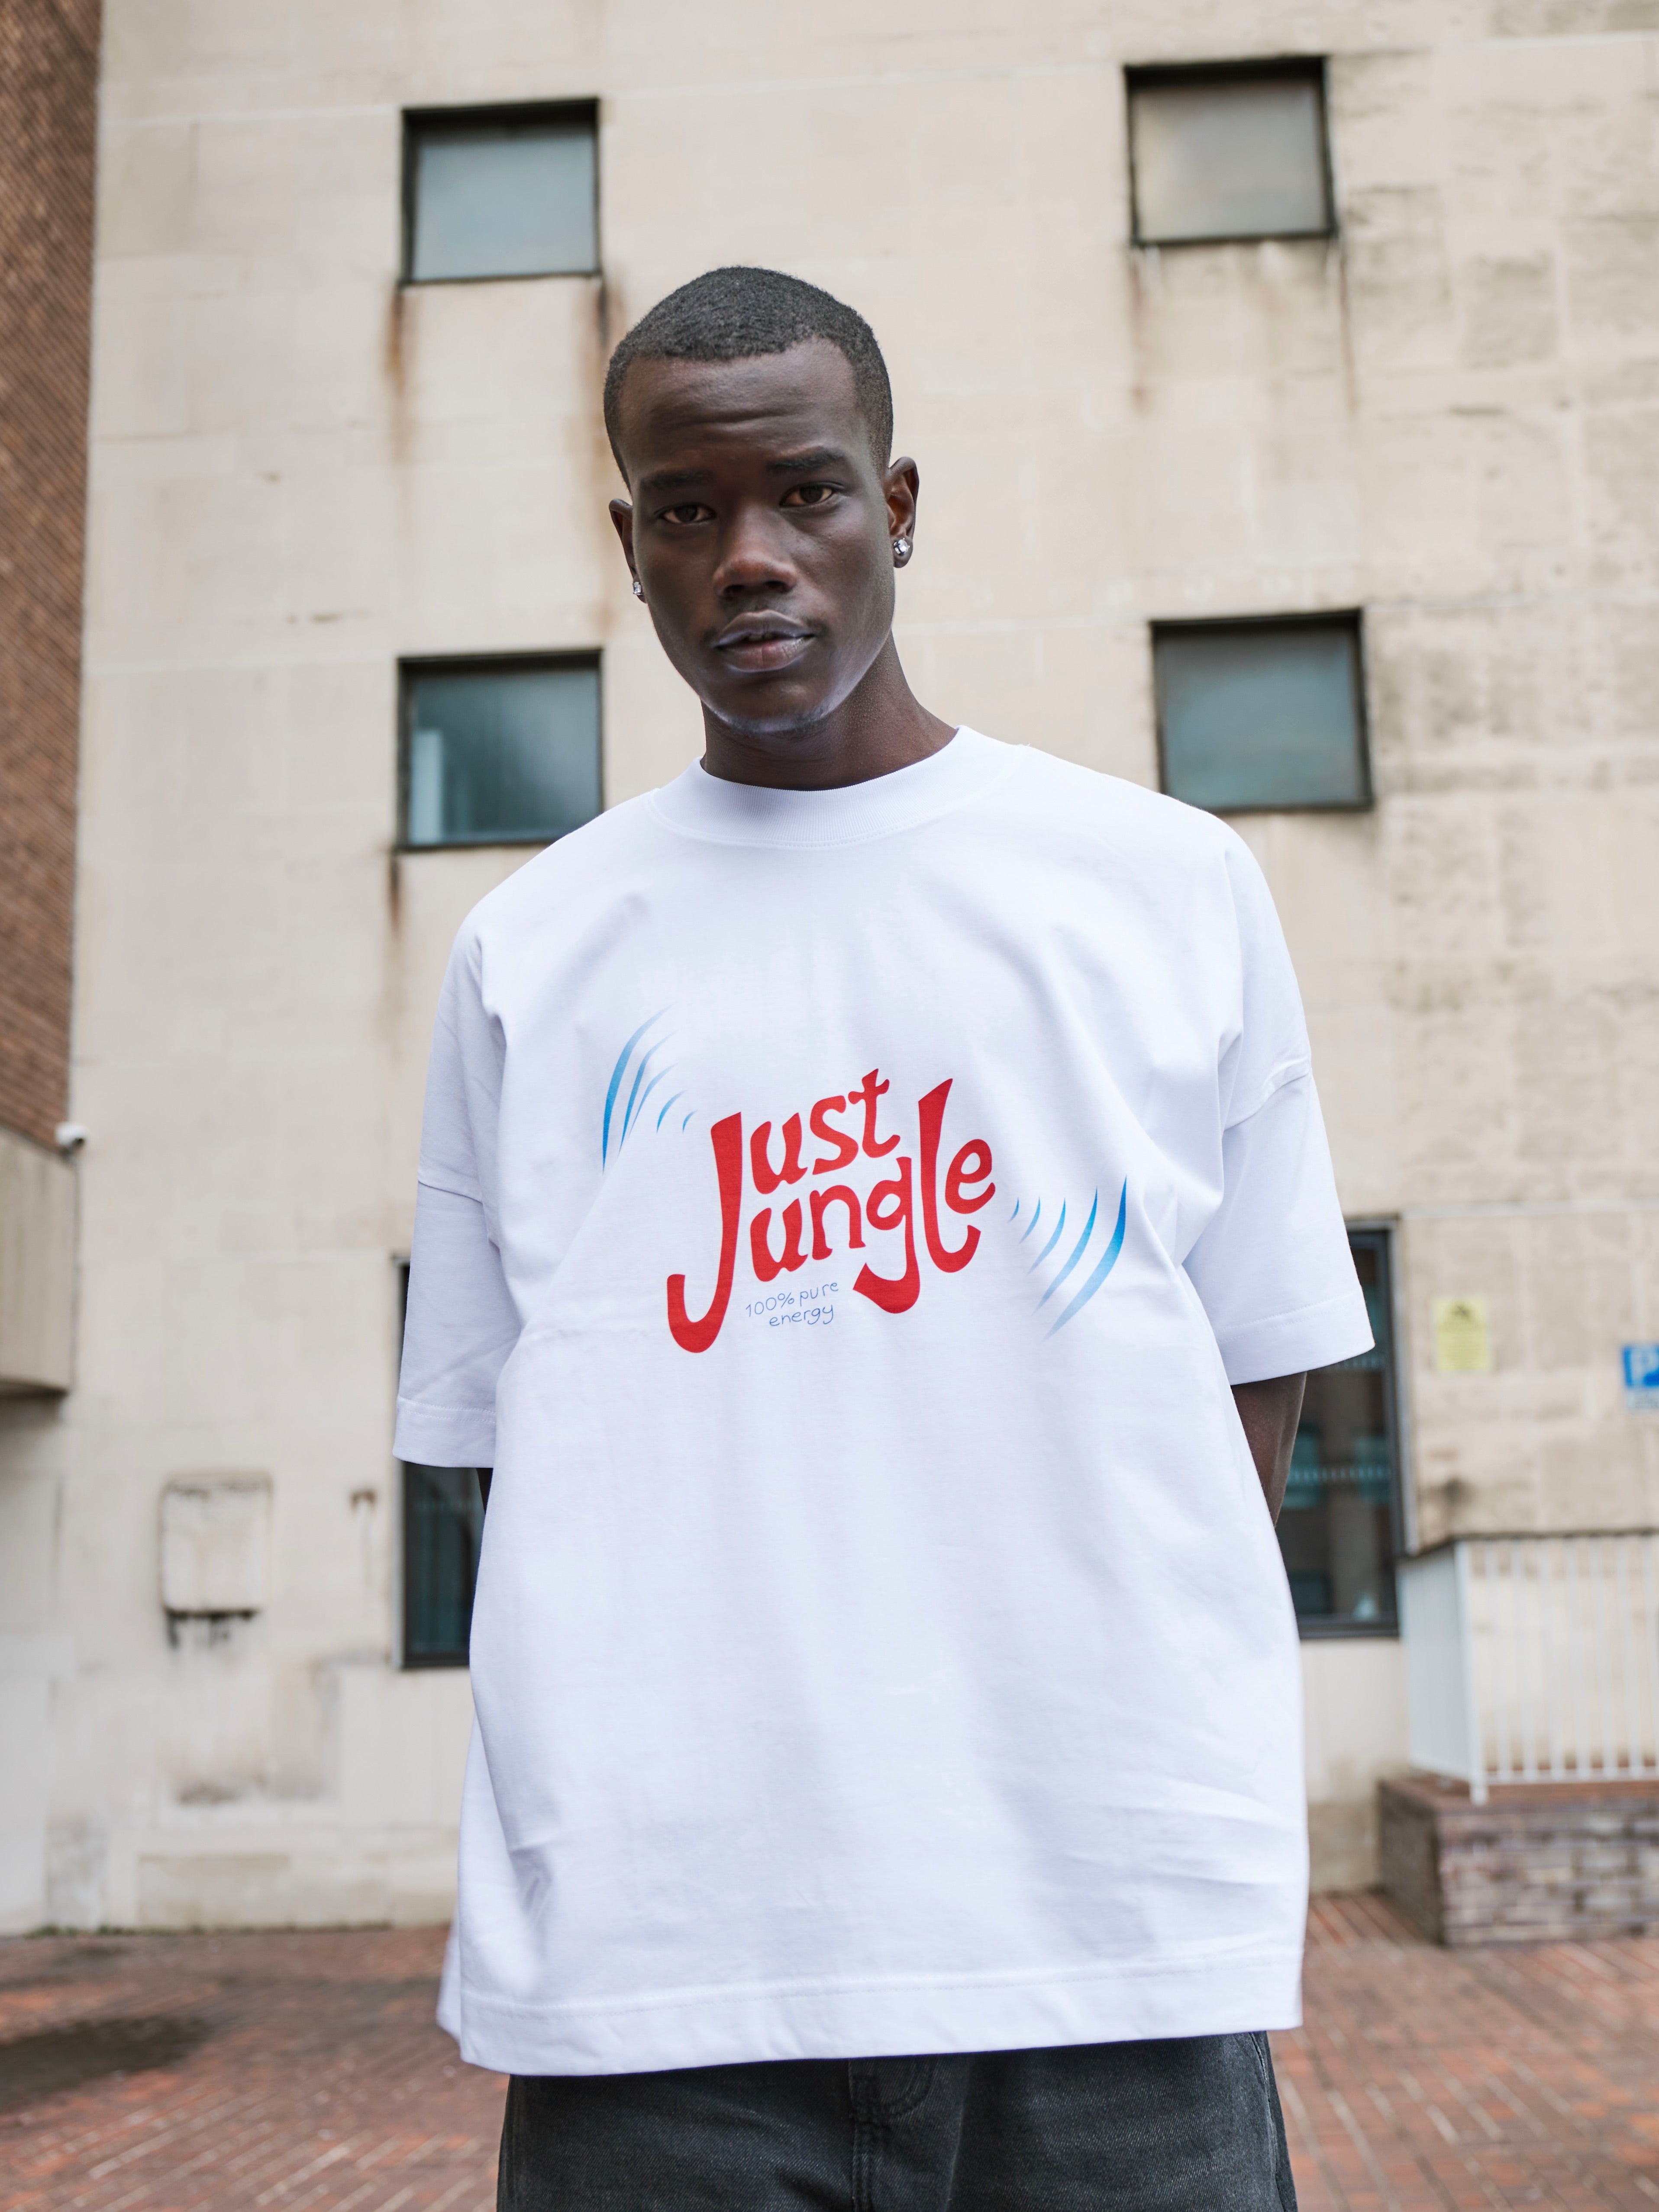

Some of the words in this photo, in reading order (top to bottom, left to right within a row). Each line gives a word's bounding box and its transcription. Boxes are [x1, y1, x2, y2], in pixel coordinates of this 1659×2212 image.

[667, 1069, 901, 1353] Just
[746, 1292, 794, 1317] 100%
[800, 1282, 839, 1307] pure
[769, 1304, 834, 1326] energy
